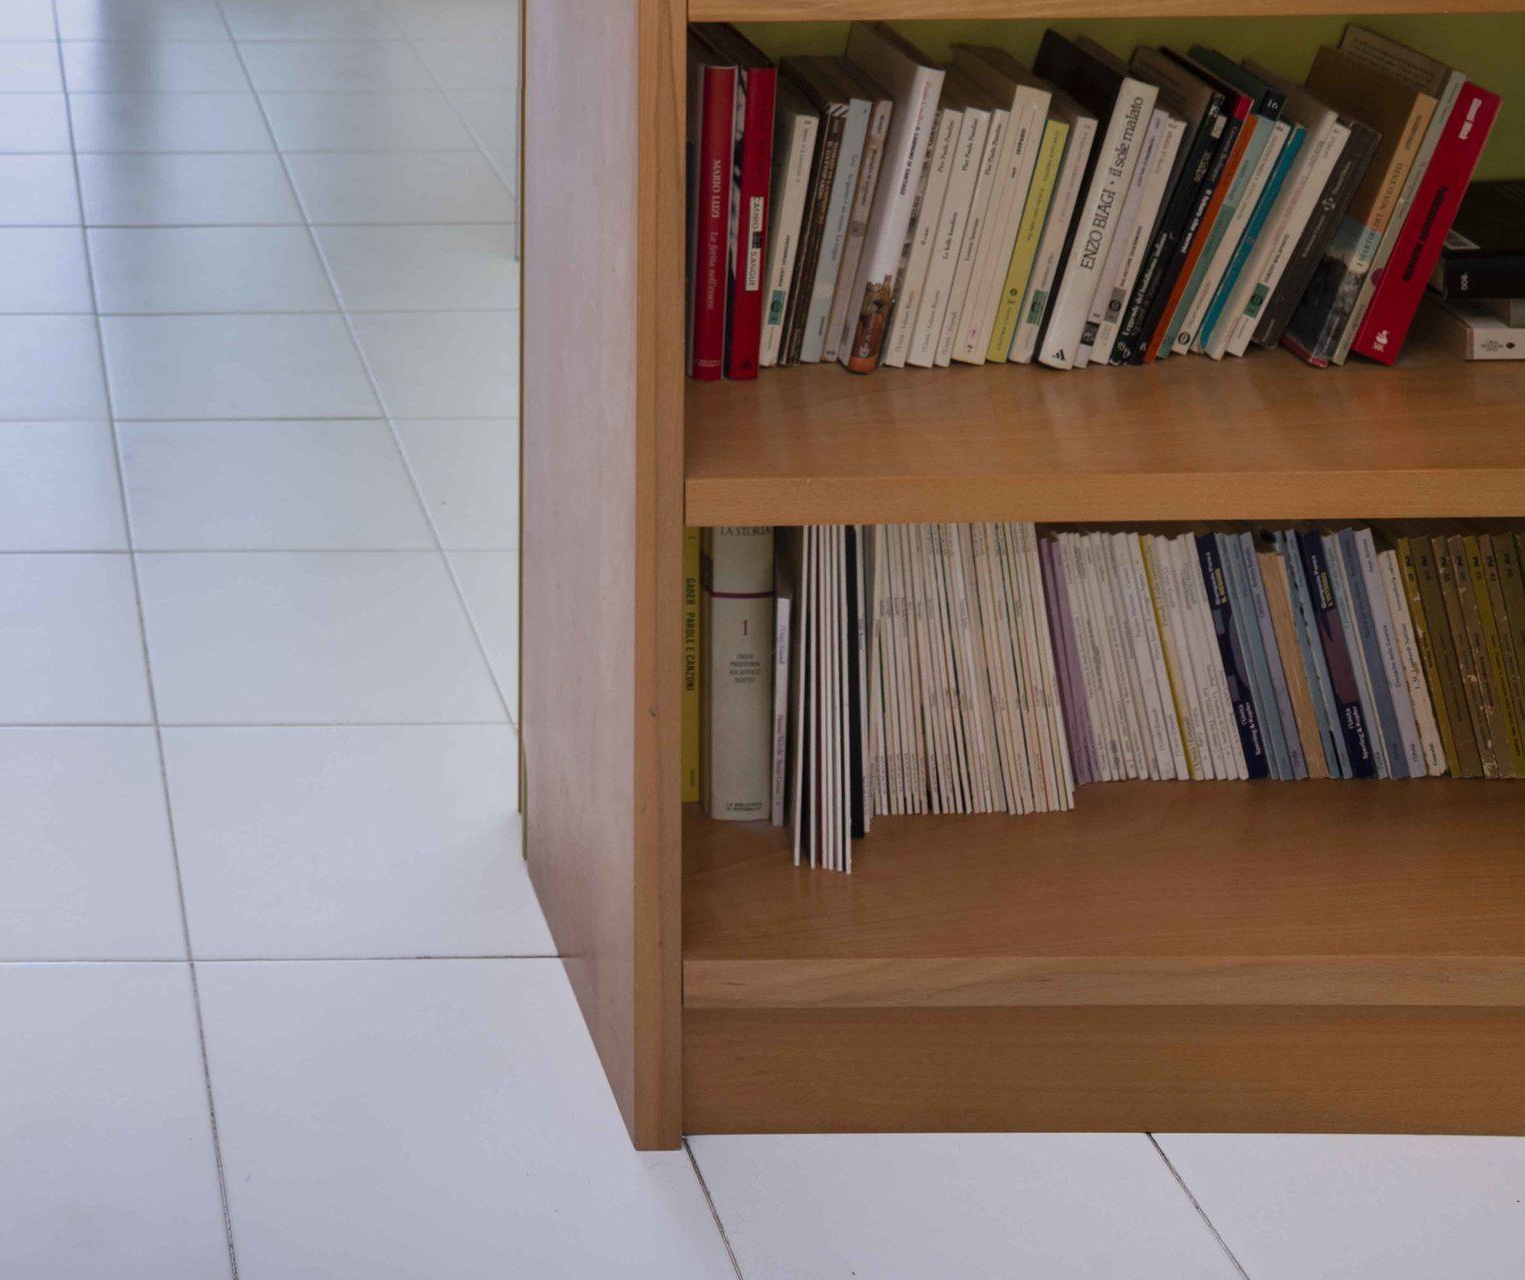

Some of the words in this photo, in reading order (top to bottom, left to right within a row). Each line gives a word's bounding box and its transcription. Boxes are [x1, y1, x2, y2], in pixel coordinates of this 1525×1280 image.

[1123, 96, 1145, 141] malato
[1113, 135, 1134, 166] sole
[713, 160, 722, 191] MARIO
[1108, 166, 1121, 180] il
[712, 193, 720, 219] LUZI
[1091, 188, 1117, 230] BIAGI
[1079, 228, 1103, 272] ENZO
[685, 577, 697, 606] GABER
[685, 611, 697, 643] PAROLE
[685, 644, 694, 652] E
[685, 653, 694, 692] CANZONI
